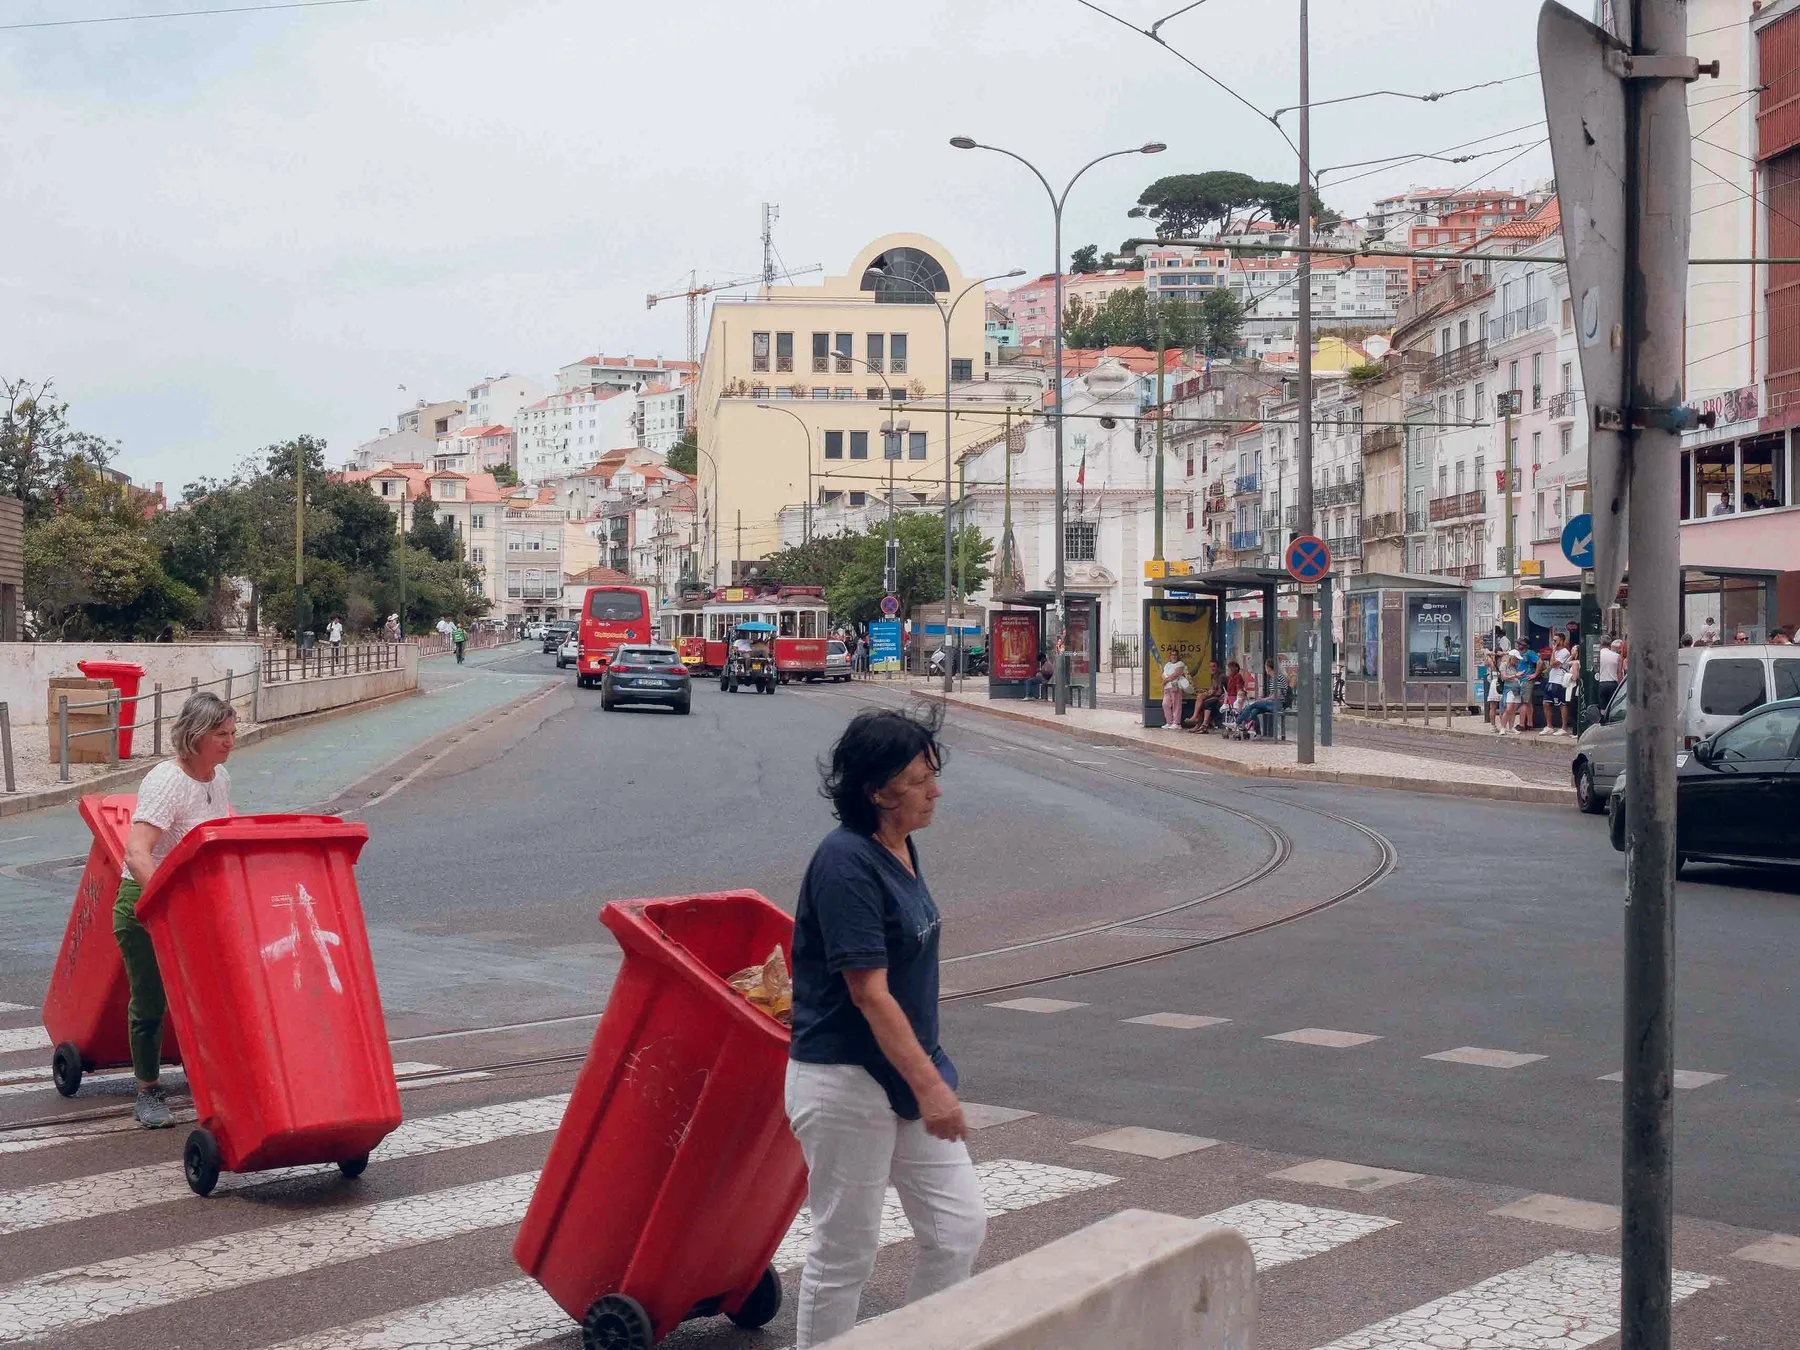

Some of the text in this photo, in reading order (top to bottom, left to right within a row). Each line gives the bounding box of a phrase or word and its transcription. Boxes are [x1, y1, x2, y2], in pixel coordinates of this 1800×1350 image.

[1703, 397, 1722, 417] BBQ
[1418, 613, 1452, 623] FARO
[1160, 644, 1202, 652] SALDOS
